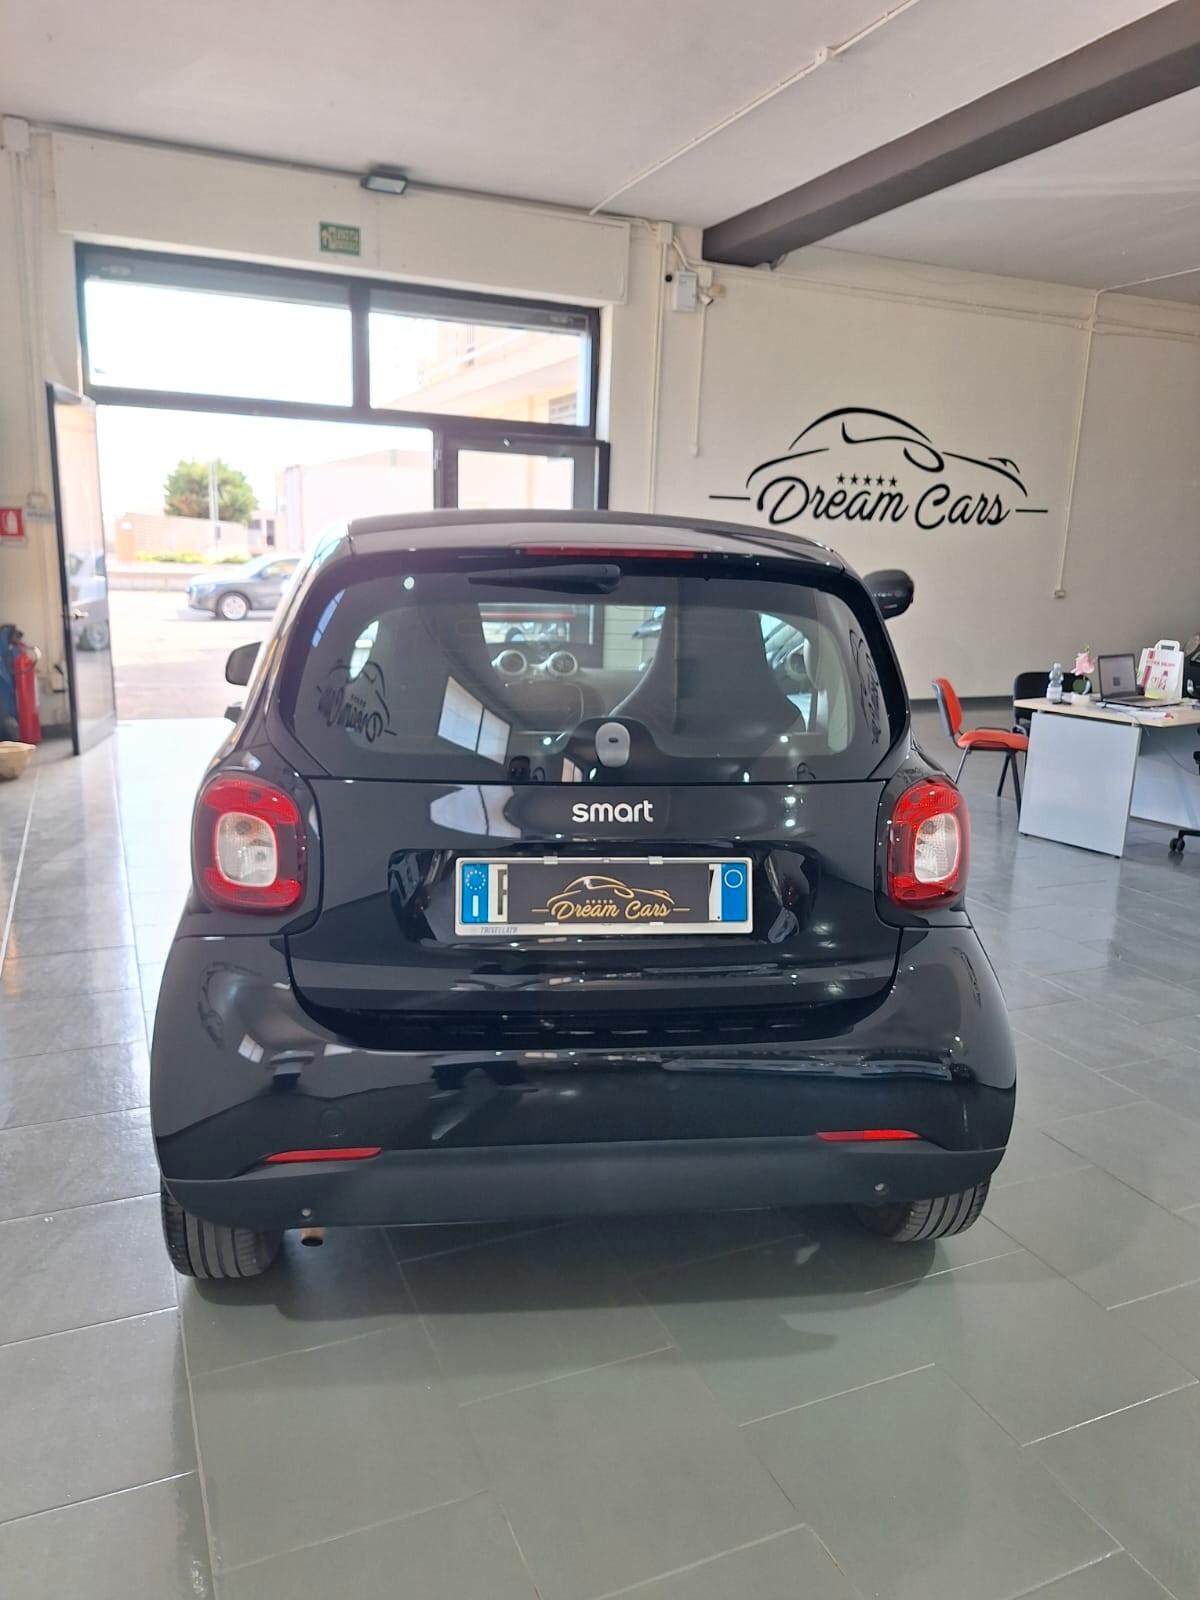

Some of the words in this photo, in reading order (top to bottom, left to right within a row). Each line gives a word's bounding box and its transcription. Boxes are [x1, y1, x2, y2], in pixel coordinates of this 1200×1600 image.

[756, 475, 909, 525] Dream
[915, 483, 1011, 530] Cars
[572, 799, 654, 823] smart
[551, 900, 620, 920] Dream
[624, 900, 671, 919] Cars
